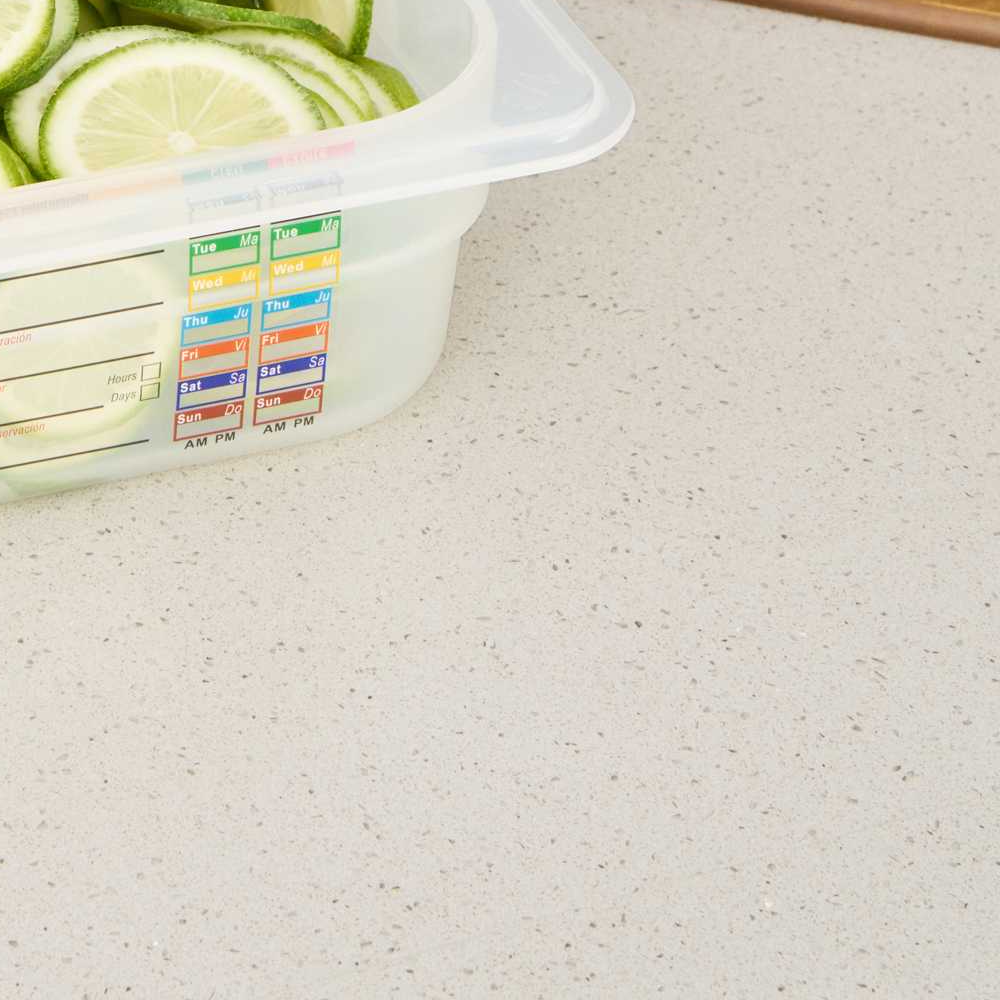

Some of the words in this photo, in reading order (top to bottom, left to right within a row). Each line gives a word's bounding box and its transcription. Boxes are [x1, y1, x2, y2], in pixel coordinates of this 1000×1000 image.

[273, 228, 298, 240] Tue
[321, 218, 339, 232] Ma
[192, 242, 217, 255] Tue
[240, 234, 258, 247] Ma
[273, 261, 304, 276] Wed
[321, 254, 337, 267] Mi
[193, 276, 224, 291] Wed
[241, 270, 256, 282] Mi
[266, 299, 289, 312] Thu
[314, 291, 330, 303] Ju
[184, 315, 208, 328] Thu
[234, 306, 249, 319] Ju
[261, 334, 279, 346] Fri
[314, 324, 326, 336] Vi
[182, 349, 199, 361] Fri
[235, 339, 247, 351] Vi
[260, 365, 281, 377] Sat
[309, 356, 325, 368] Sa
[107, 372, 137, 385] Hours
[180, 381, 201, 393] Sat
[229, 372, 246, 385] Sa
[111, 392, 136, 403] Days
[256, 397, 281, 409] Sun
[304, 388, 321, 400] Do
[177, 412, 202, 424] Sun
[225, 404, 242, 416] Do
[263, 421, 286, 434] AM
[294, 416, 314, 428] PM
[184, 437, 207, 450] AM
[215, 431, 236, 443] PM
